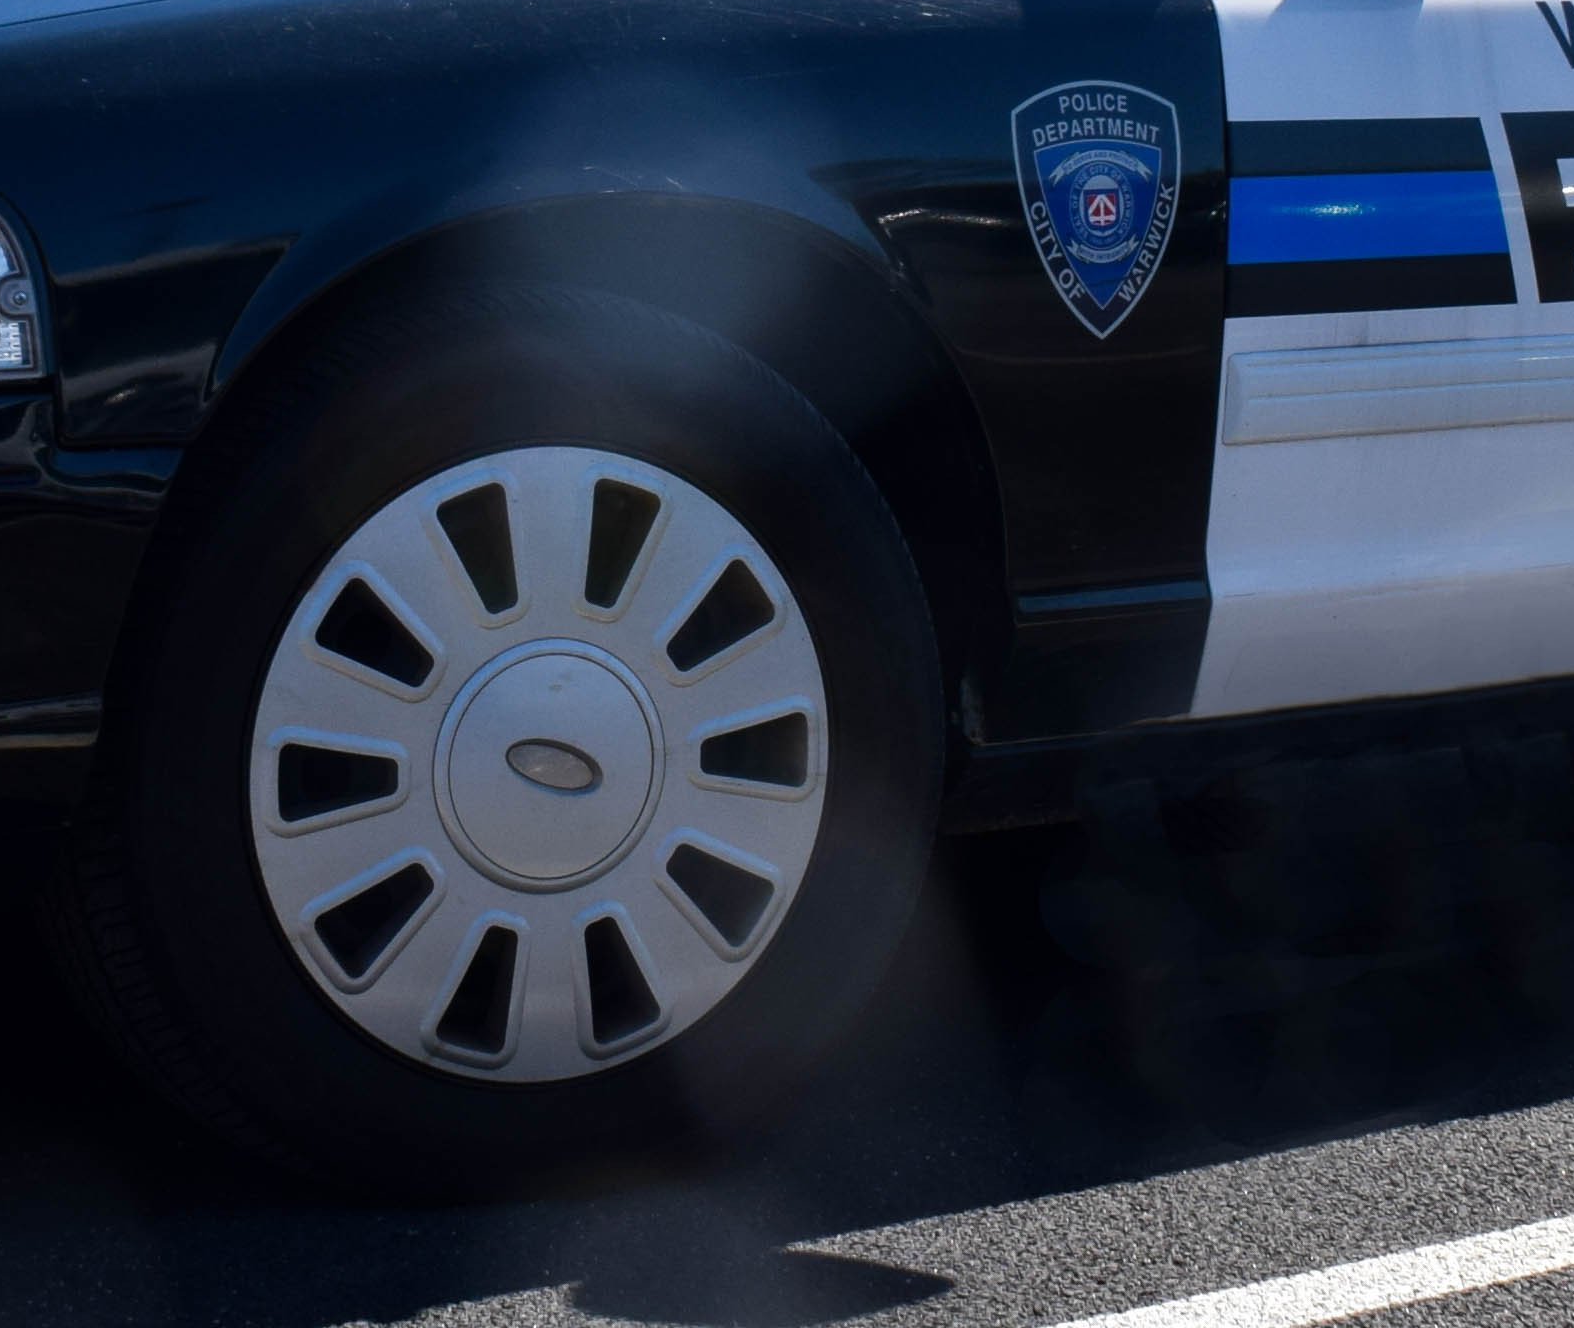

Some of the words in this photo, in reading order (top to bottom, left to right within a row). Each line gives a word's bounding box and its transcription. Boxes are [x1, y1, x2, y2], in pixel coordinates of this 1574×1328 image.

[1058, 93, 1128, 113] POLICE
[1032, 118, 1160, 147] DEPARTMENT
[1030, 202, 1063, 260] CITY
[1058, 268, 1086, 300] OF
[1118, 183, 1174, 303] WARWICK
